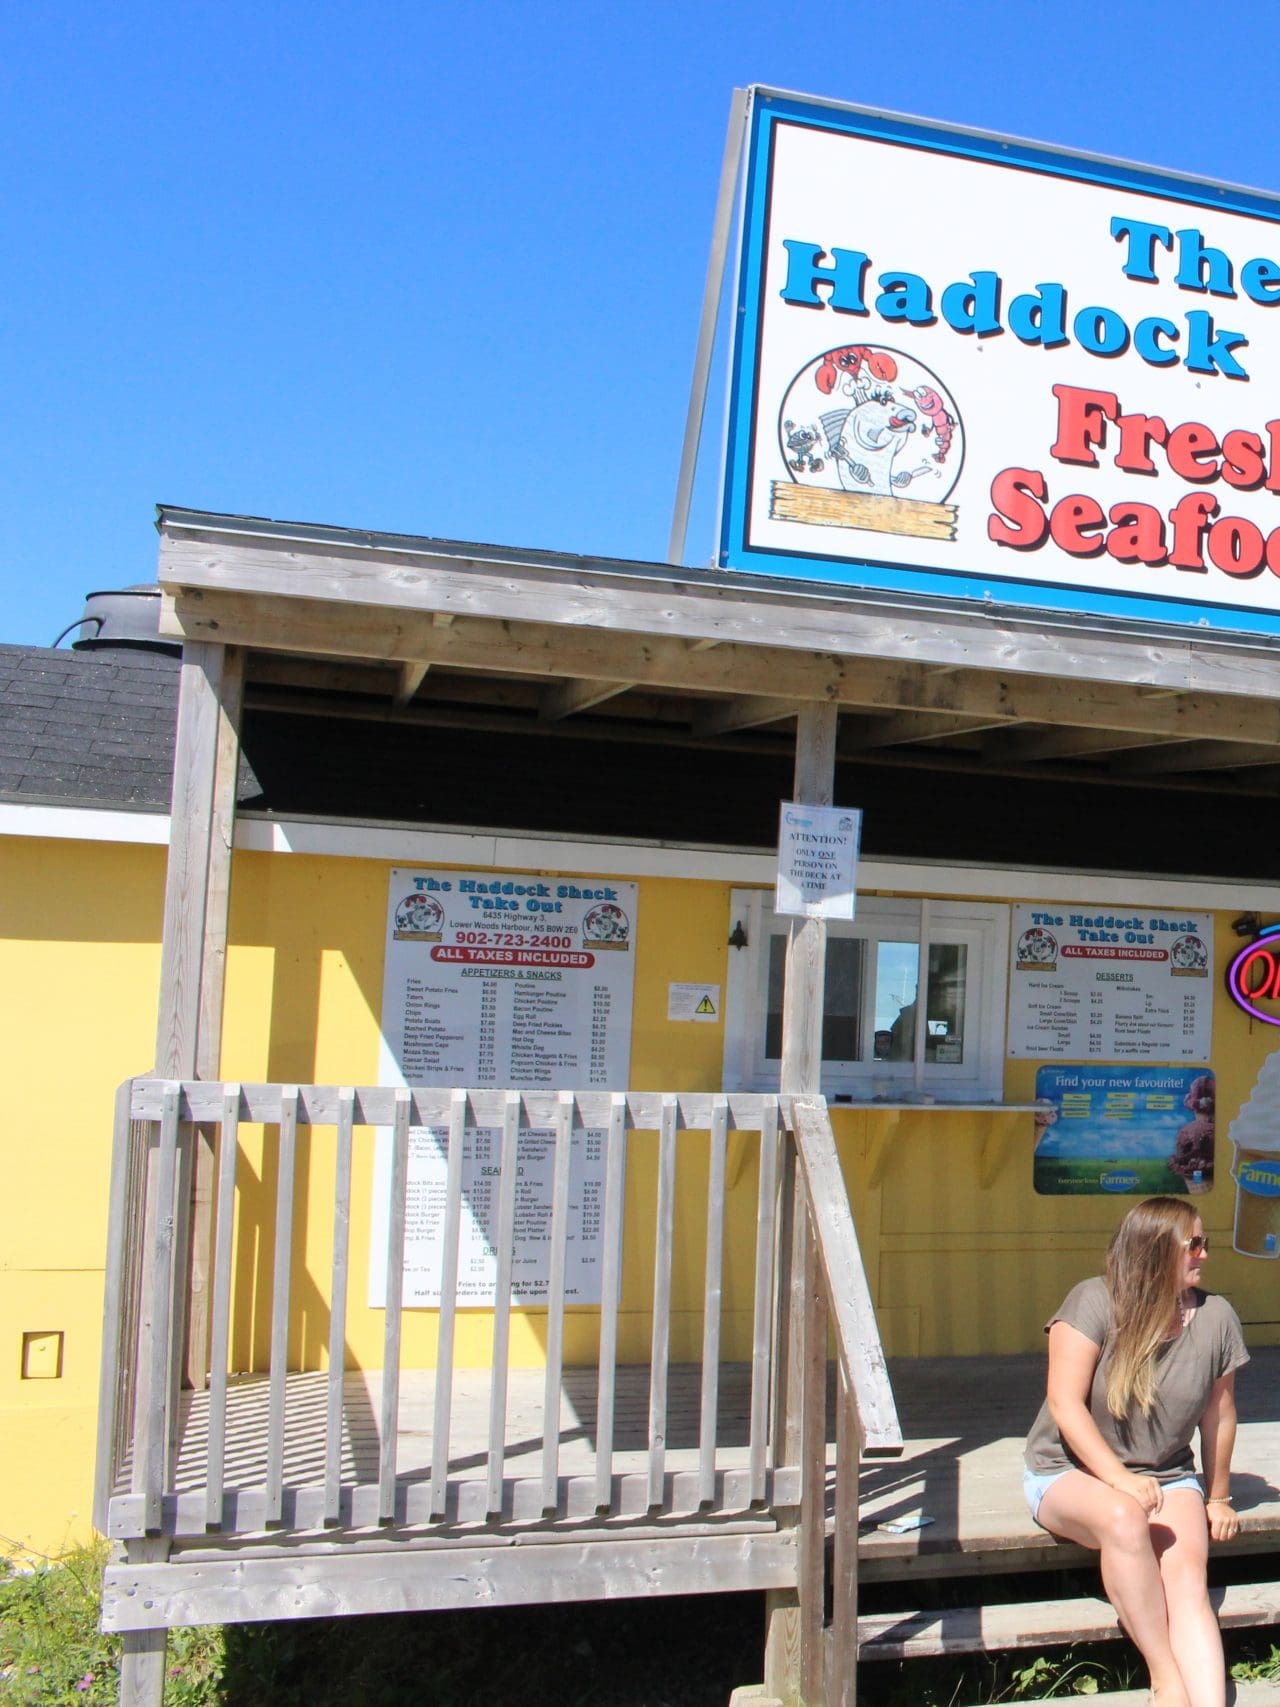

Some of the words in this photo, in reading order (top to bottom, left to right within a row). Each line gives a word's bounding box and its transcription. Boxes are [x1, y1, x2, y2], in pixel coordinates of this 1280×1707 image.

[780, 240, 1250, 381] Haddock
[789, 833, 847, 845] ATTENTION!
[796, 849, 815, 857] ONLY
[818, 850, 836, 859] ONE
[794, 860, 824, 868] PERSON
[825, 861, 838, 869] ON
[805, 871, 828, 879] DECK
[413, 877, 452, 891] The
[459, 880, 551, 897] Haddock
[556, 885, 618, 900] Shack
[469, 896, 519, 910] Take
[526, 899, 562, 913] Out
[504, 912, 539, 922] Highway
[1031, 912, 1064, 926] The
[1069, 914, 1144, 930] Haddock
[1149, 919, 1198, 932] Shack
[450, 921, 472, 929] Lower
[474, 922, 500, 930] Woods
[501, 923, 532, 932] Harbour,
[534, 924, 545, 932] NS
[456, 931, 571, 949] 902-723-2400
[1078, 929, 1119, 942] Take
[1124, 931, 1154, 944] Out
[437, 948, 464, 959] ALL
[467, 949, 514, 961] TAXES
[518, 951, 588, 964] INCLUDED
[1065, 947, 1083, 955] ALL
[1086, 948, 1116, 957] TAXES
[1118, 950, 1165, 959] INCLUDED
[461, 968, 515, 978] APPETIZERS
[526, 971, 562, 981] SNACKS
[1096, 972, 1134, 982] DESSERTS
[1055, 1075, 1079, 1086] Find
[1081, 1078, 1106, 1089] your
[1109, 1079, 1132, 1088] new
[1135, 1078, 1184, 1089] favourite!
[1100, 1173, 1140, 1185] Farmers
